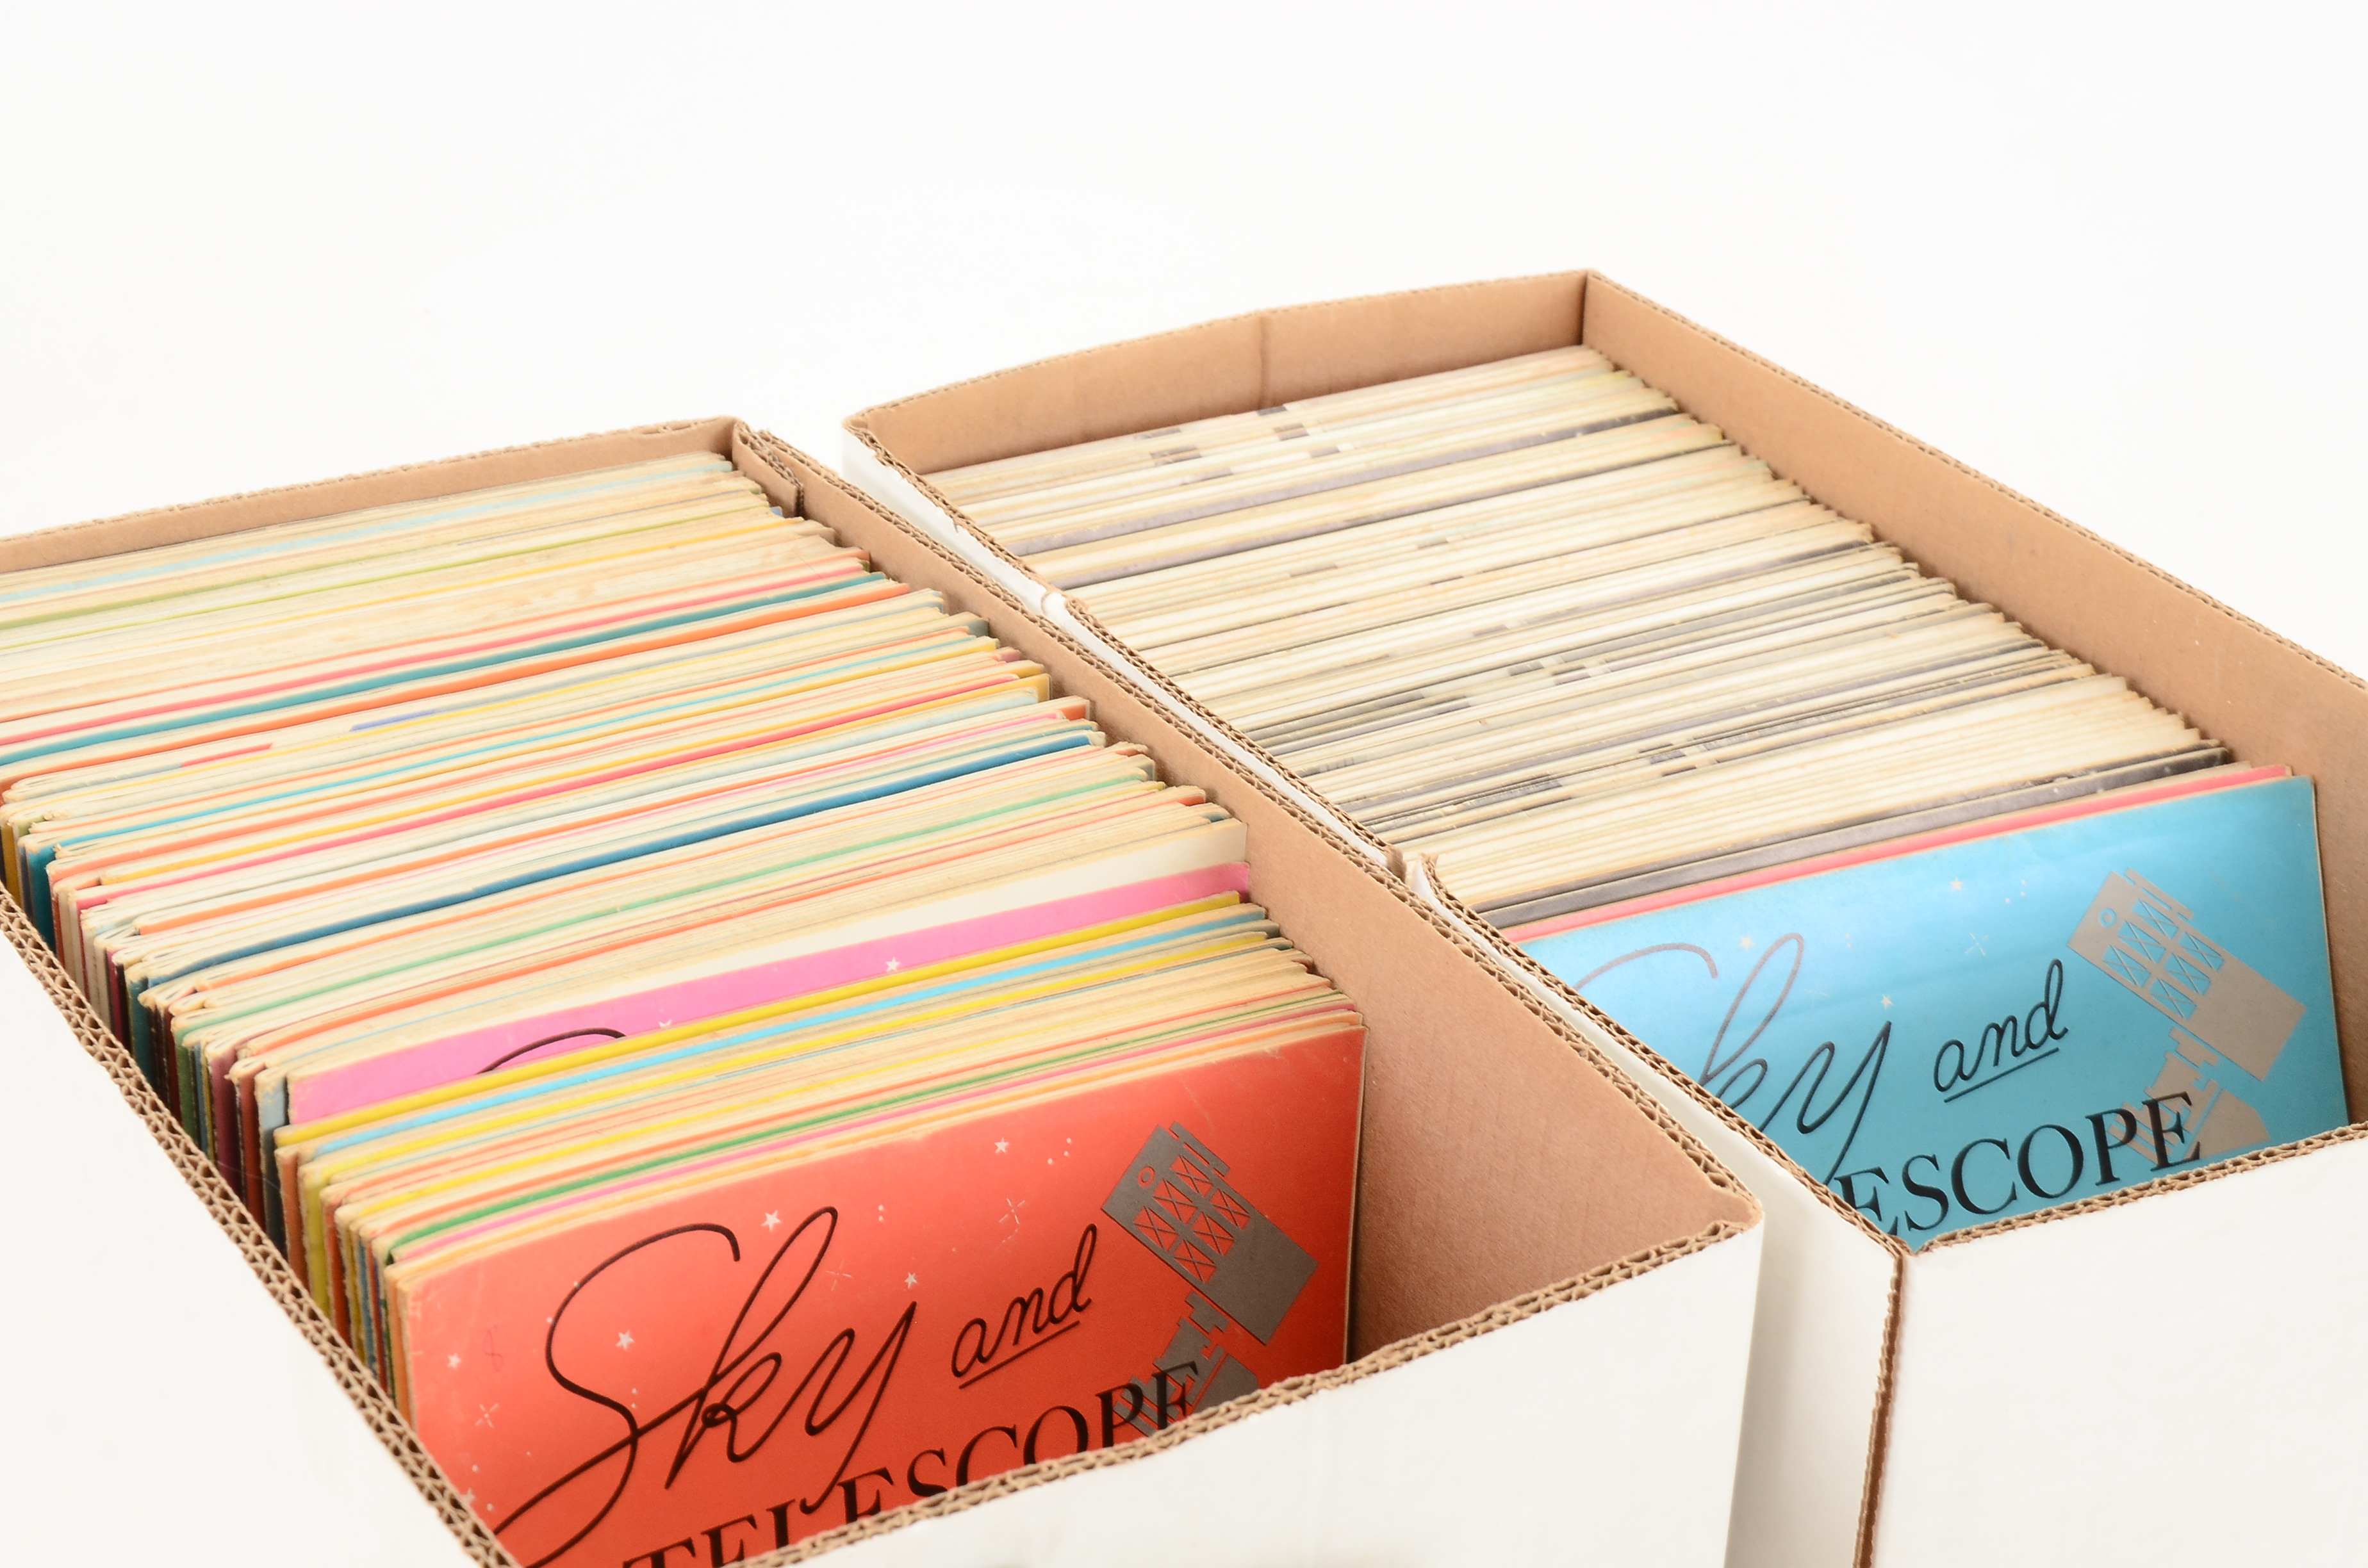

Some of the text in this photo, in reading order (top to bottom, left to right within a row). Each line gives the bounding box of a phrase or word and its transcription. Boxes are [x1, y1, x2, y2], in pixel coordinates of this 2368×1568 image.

[1573, 932, 2068, 1186] ky and
[1834, 1091, 2201, 1236] ESCOPE
[492, 1207, 1097, 1568] Sky and
